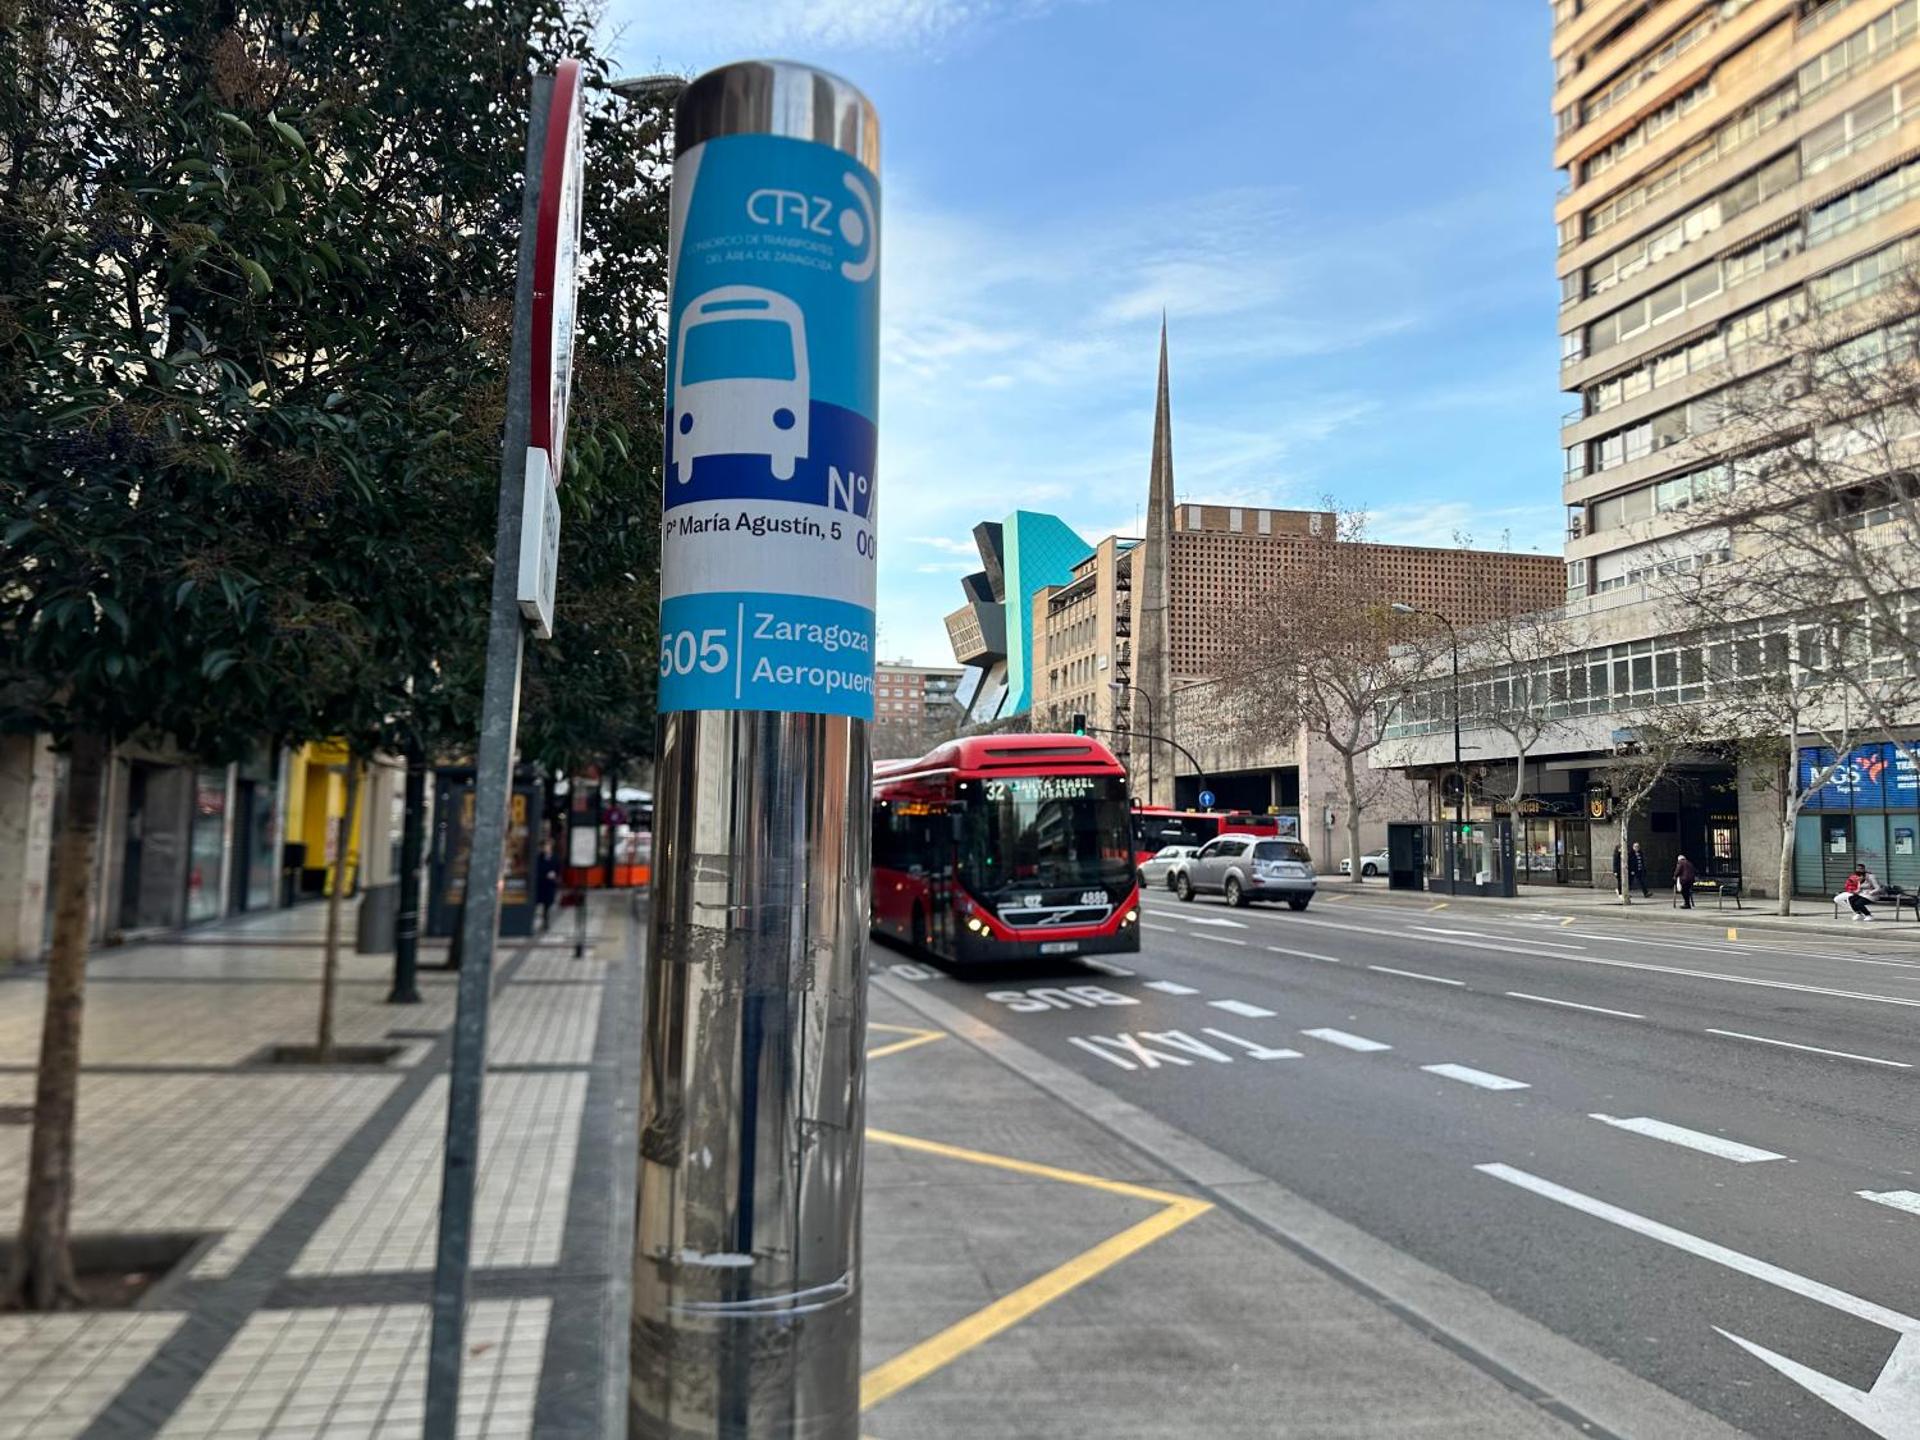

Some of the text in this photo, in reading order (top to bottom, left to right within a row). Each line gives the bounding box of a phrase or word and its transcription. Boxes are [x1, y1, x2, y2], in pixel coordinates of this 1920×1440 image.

[746, 188, 833, 236] CTAZ
[745, 234, 758, 246] DE
[680, 513, 730, 536] María
[735, 512, 826, 540] Agustín,
[831, 522, 842, 540] 5
[753, 612, 869, 653] Zaragoza
[660, 629, 729, 678] 505
[986, 781, 1005, 801] 32
[985, 984, 1142, 1013] BUS
[1067, 1027, 1304, 1071] TAXI
